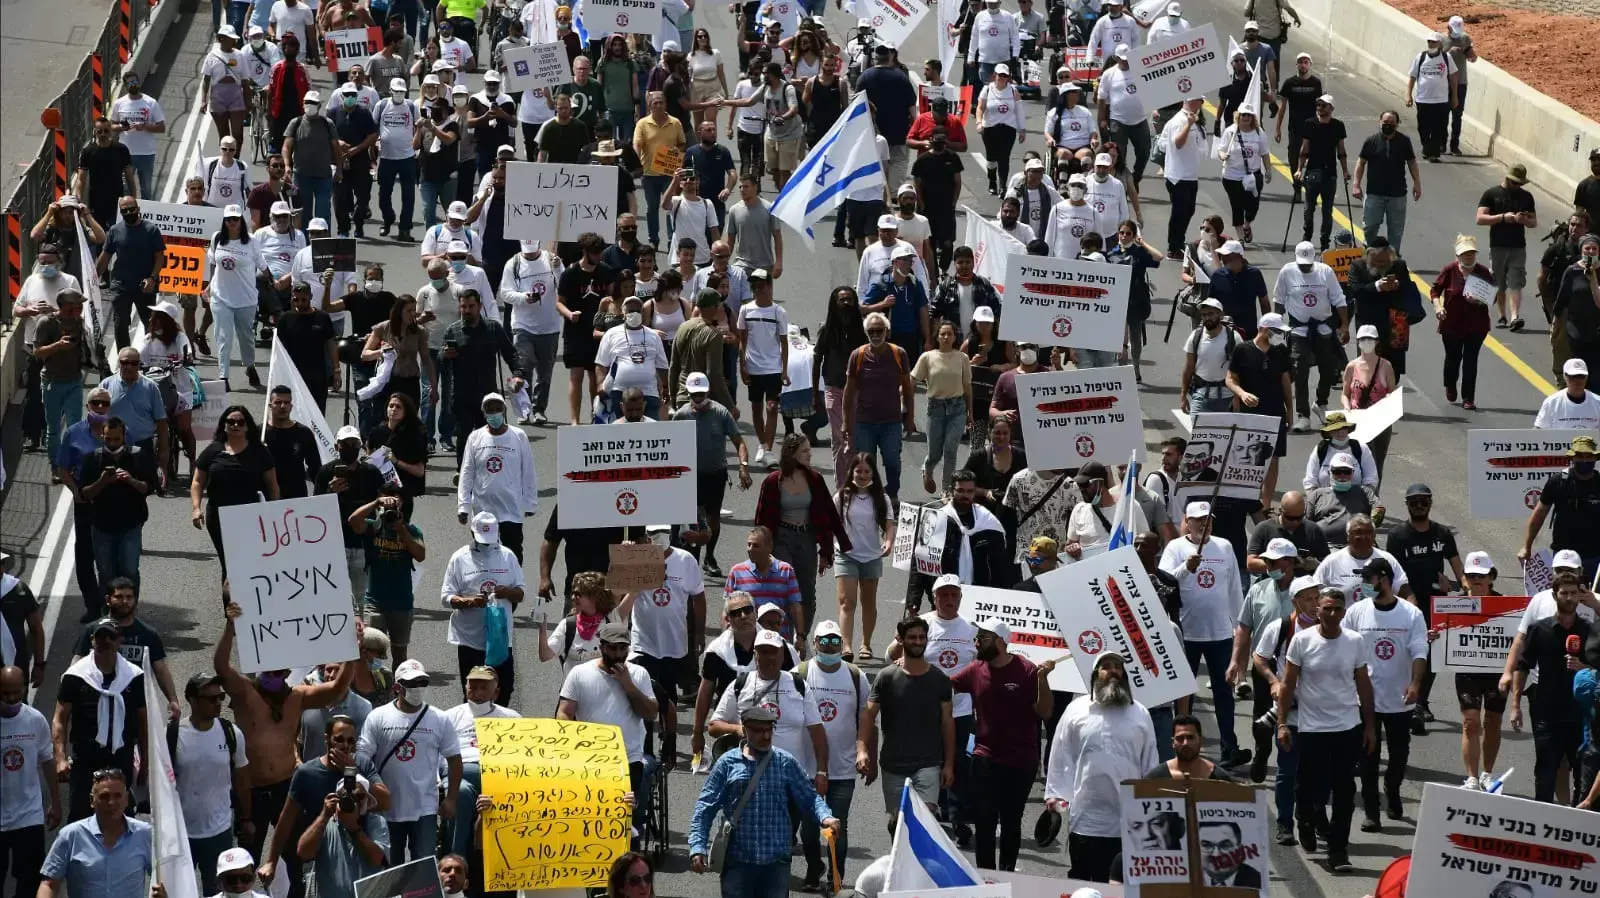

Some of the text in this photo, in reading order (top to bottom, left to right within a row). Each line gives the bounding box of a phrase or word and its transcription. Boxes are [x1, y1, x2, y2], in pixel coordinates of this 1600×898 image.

[1141, 38, 1205, 66] לא משאירים
[1141, 51, 1215, 82] פצועים מאחור
[537, 167, 591, 189] כולנו
[156, 213, 170, 222] אם
[172, 214, 183, 222] כל
[568, 203, 608, 228] איציק
[179, 226, 203, 235] משרד
[1020, 266, 1116, 285] הטיפול בנכי צה"ל
[1019, 295, 1110, 313] של מדינת ישראל
[1030, 381, 1122, 397] הטיפול בנכי צה"ל
[1036, 412, 1124, 429] של מדינת ישראל
[582, 438, 671, 452] ידעו כל אם ואב
[1483, 441, 1512, 452] צה"ל
[1516, 441, 1540, 451] בנכי
[584, 451, 669, 467] משרד הביטחון
[1486, 471, 1524, 481] ישראל
[258, 509, 327, 557] כולנו
[250, 563, 338, 615] איציק
[975, 601, 998, 613] ואב
[1003, 604, 1022, 616] אם
[1026, 607, 1040, 618] כל
[1119, 566, 1178, 681] הטיפול בנכי צה"ל
[1493, 626, 1504, 634] נכי
[251, 613, 348, 665] סעידיאן
[1017, 632, 1037, 644] את
[1088, 578, 1145, 688] של מדינת ישראל
[1460, 634, 1514, 650] מופקרים
[1453, 650, 1477, 658] הביטחון
[1480, 652, 1498, 660] משרד
[1199, 808, 1257, 819] מיכאל ביטון
[1446, 806, 1492, 828] צה"ל
[1499, 817, 1536, 836] בנכי
[1131, 855, 1184, 867] יורה על
[1129, 865, 1188, 878] כוחותינו
[1440, 852, 1598, 894] של מדינת ישראל
